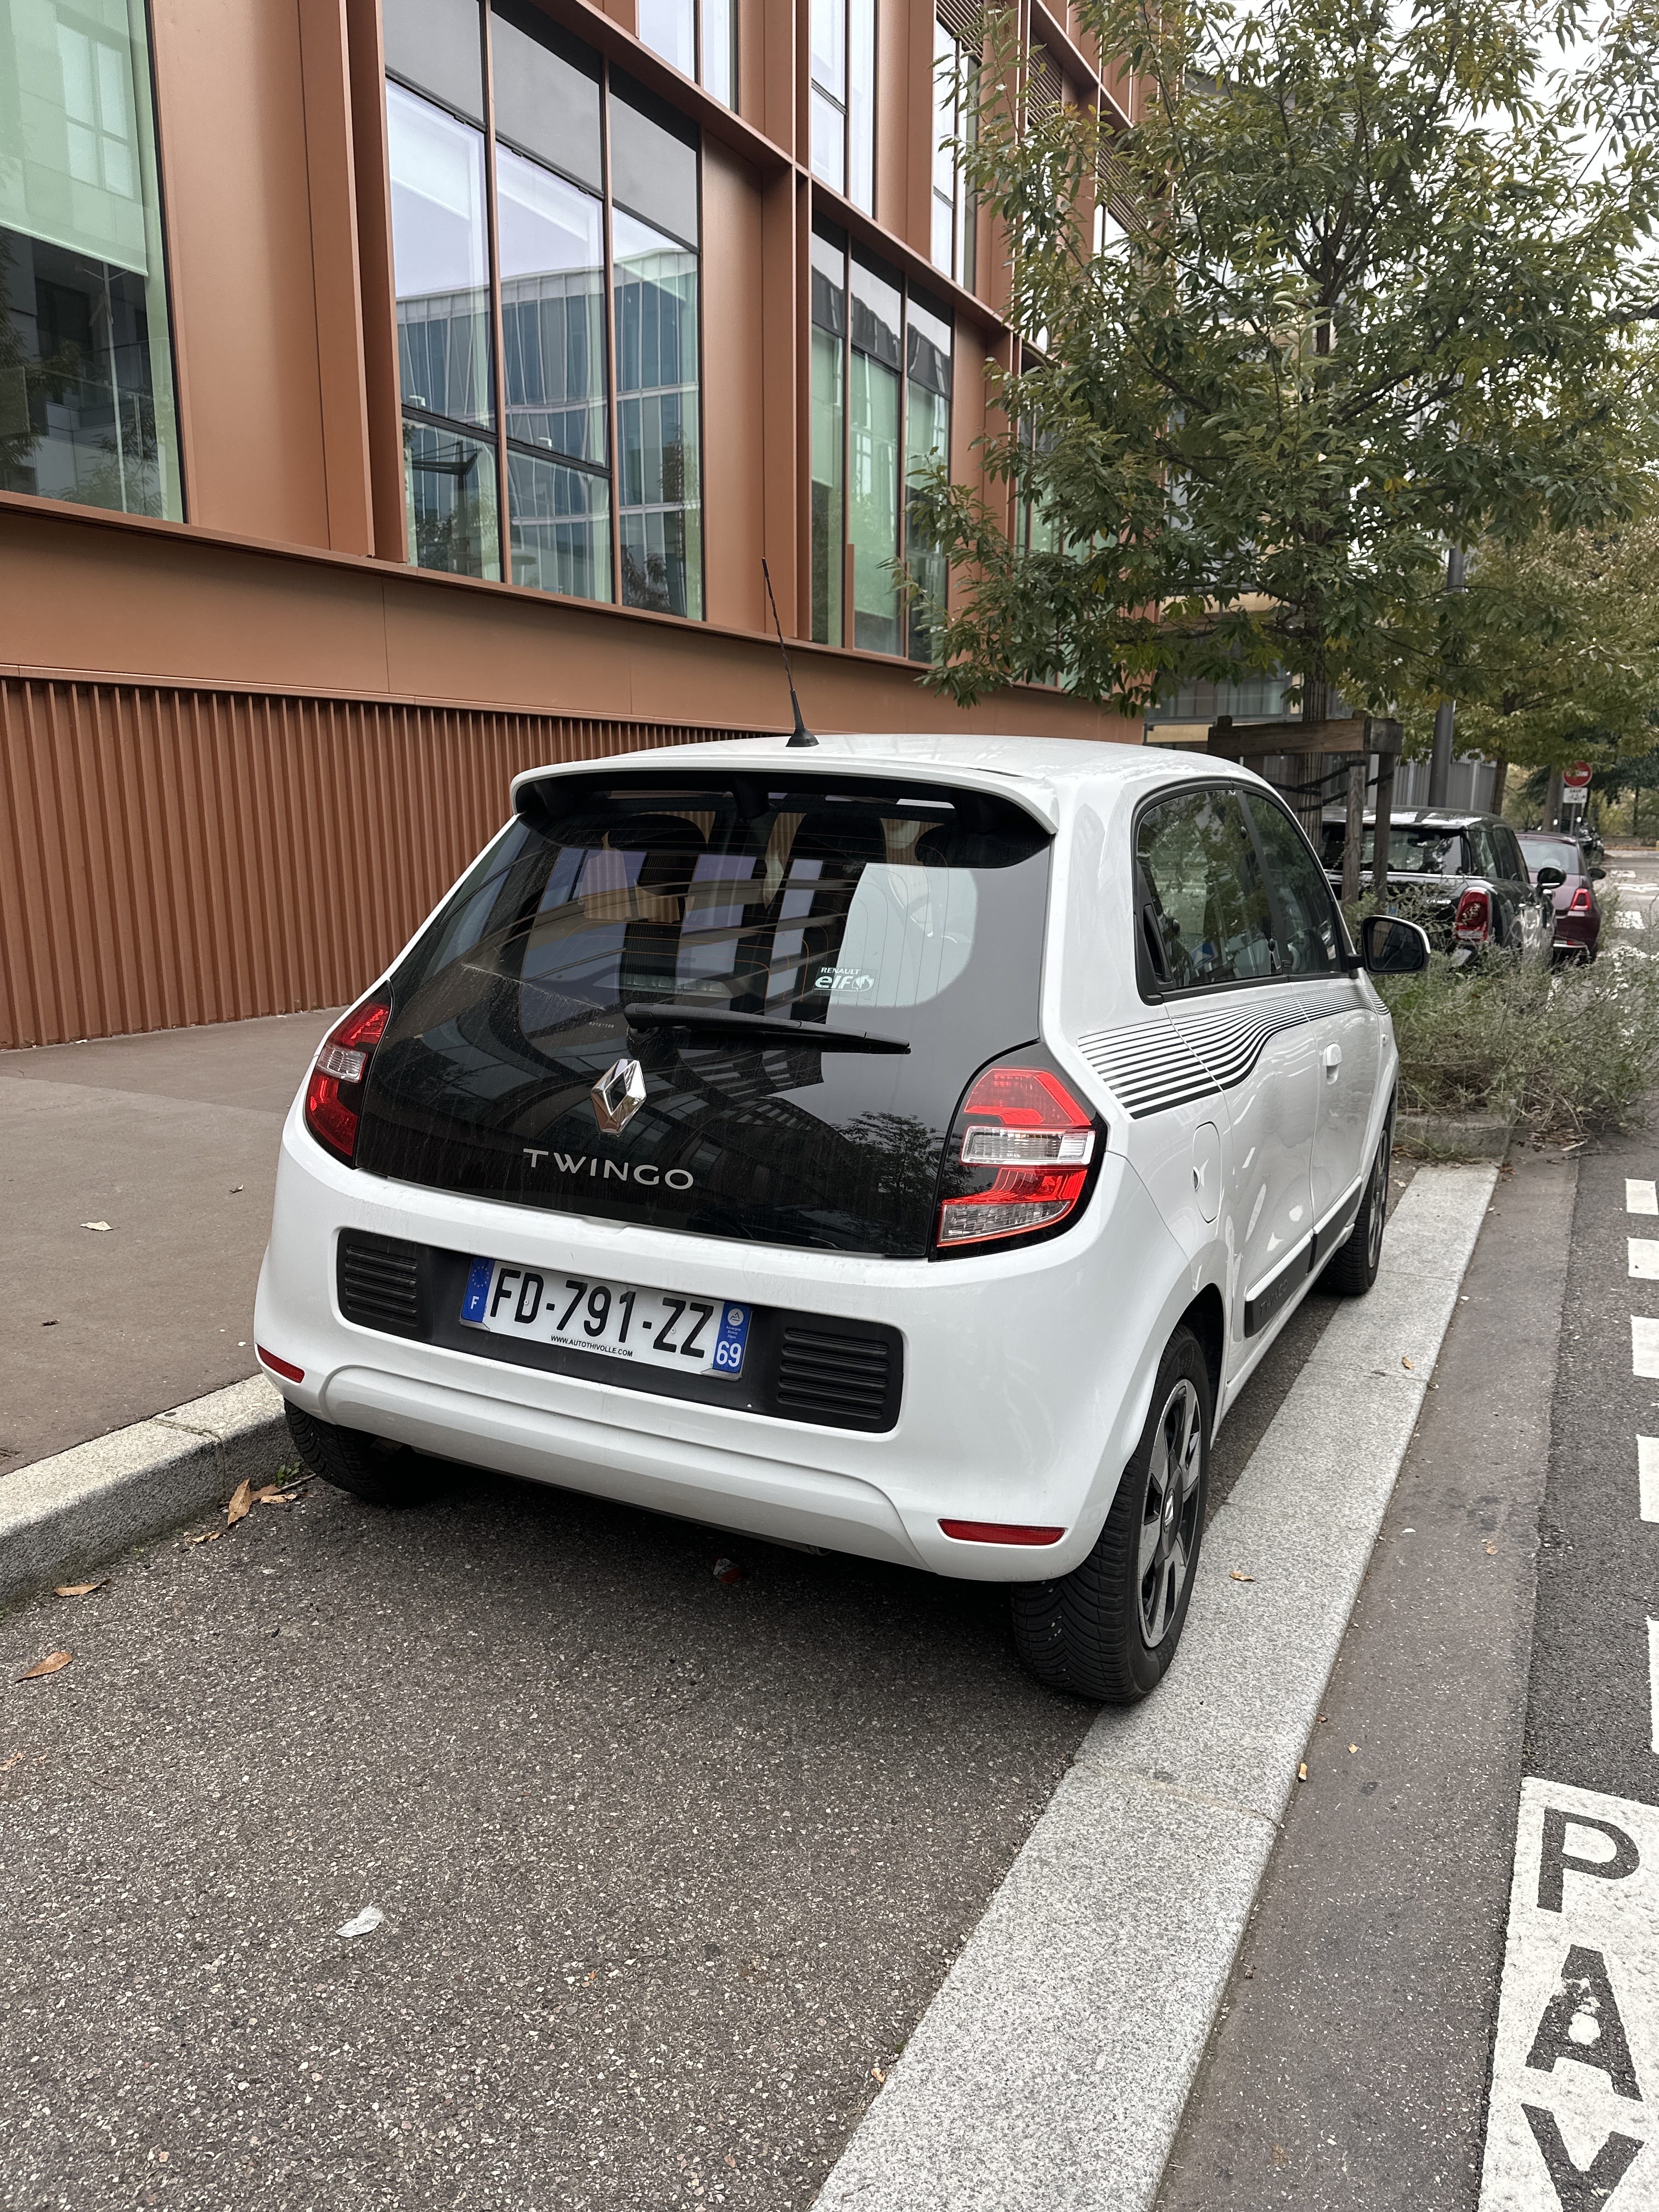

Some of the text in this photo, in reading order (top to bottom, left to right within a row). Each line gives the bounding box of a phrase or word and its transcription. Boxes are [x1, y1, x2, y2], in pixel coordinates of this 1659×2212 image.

[523, 1148, 694, 1189] TWINGO
[471, 1296, 479, 1309] F
[490, 1268, 713, 1358] FD-791-ZZ
[1260, 1278, 1288, 1316] TWINGO
[551, 1335, 633, 1357] WWW.AUTOTHIVOLLE.COM
[716, 1341, 742, 1367] 69
